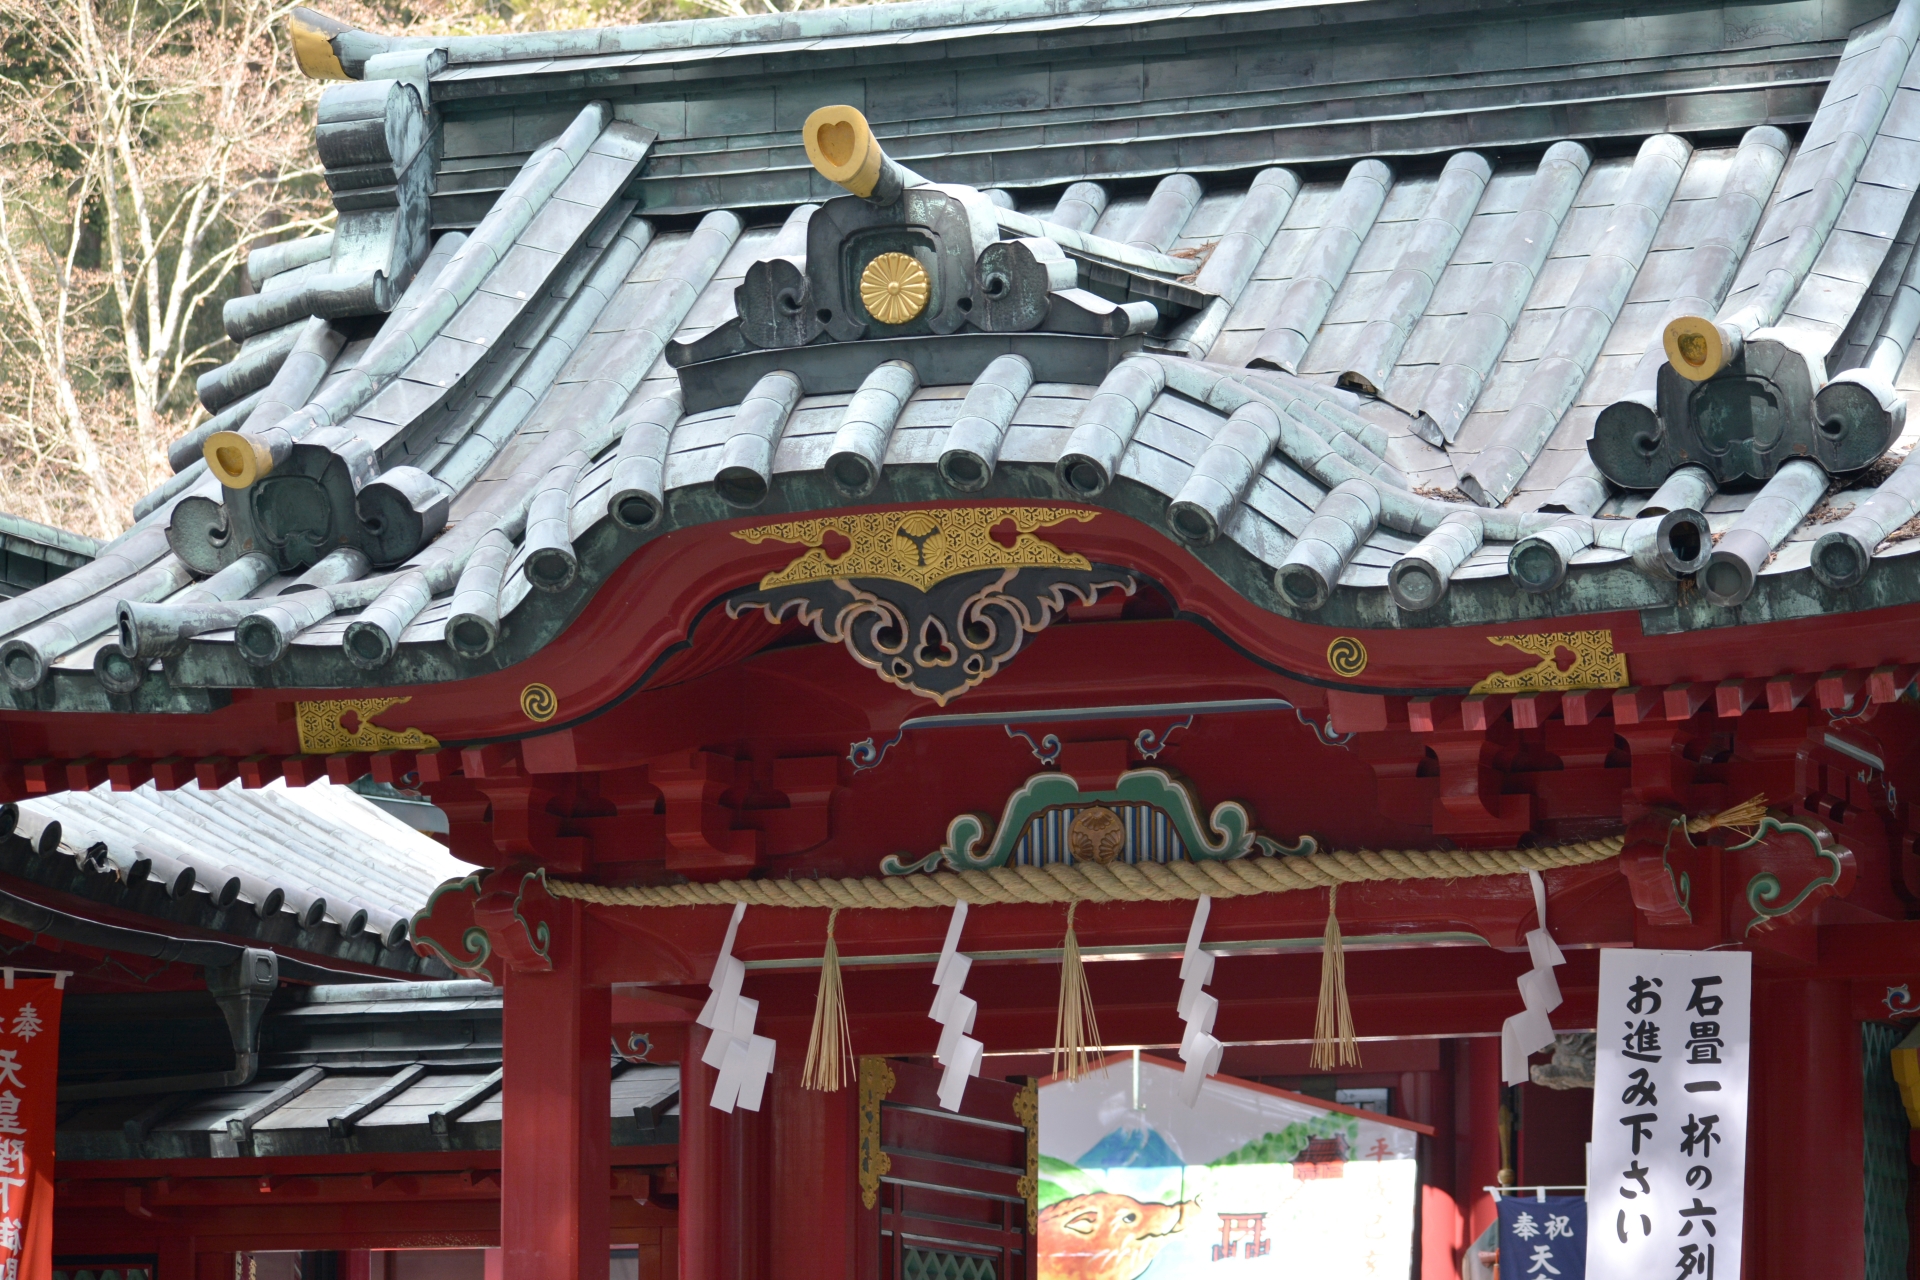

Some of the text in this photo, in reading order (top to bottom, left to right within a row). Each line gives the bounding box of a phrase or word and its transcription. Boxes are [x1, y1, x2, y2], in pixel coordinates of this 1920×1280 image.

[1616, 975, 1662, 1243] お進み下さい
[1675, 976, 1724, 1280] 石畳一杯の六列
[1363, 1138, 1394, 1277] 平己亥
[1512, 1211, 1574, 1241] 奉祝
[1527, 1245, 1561, 1280] 天
